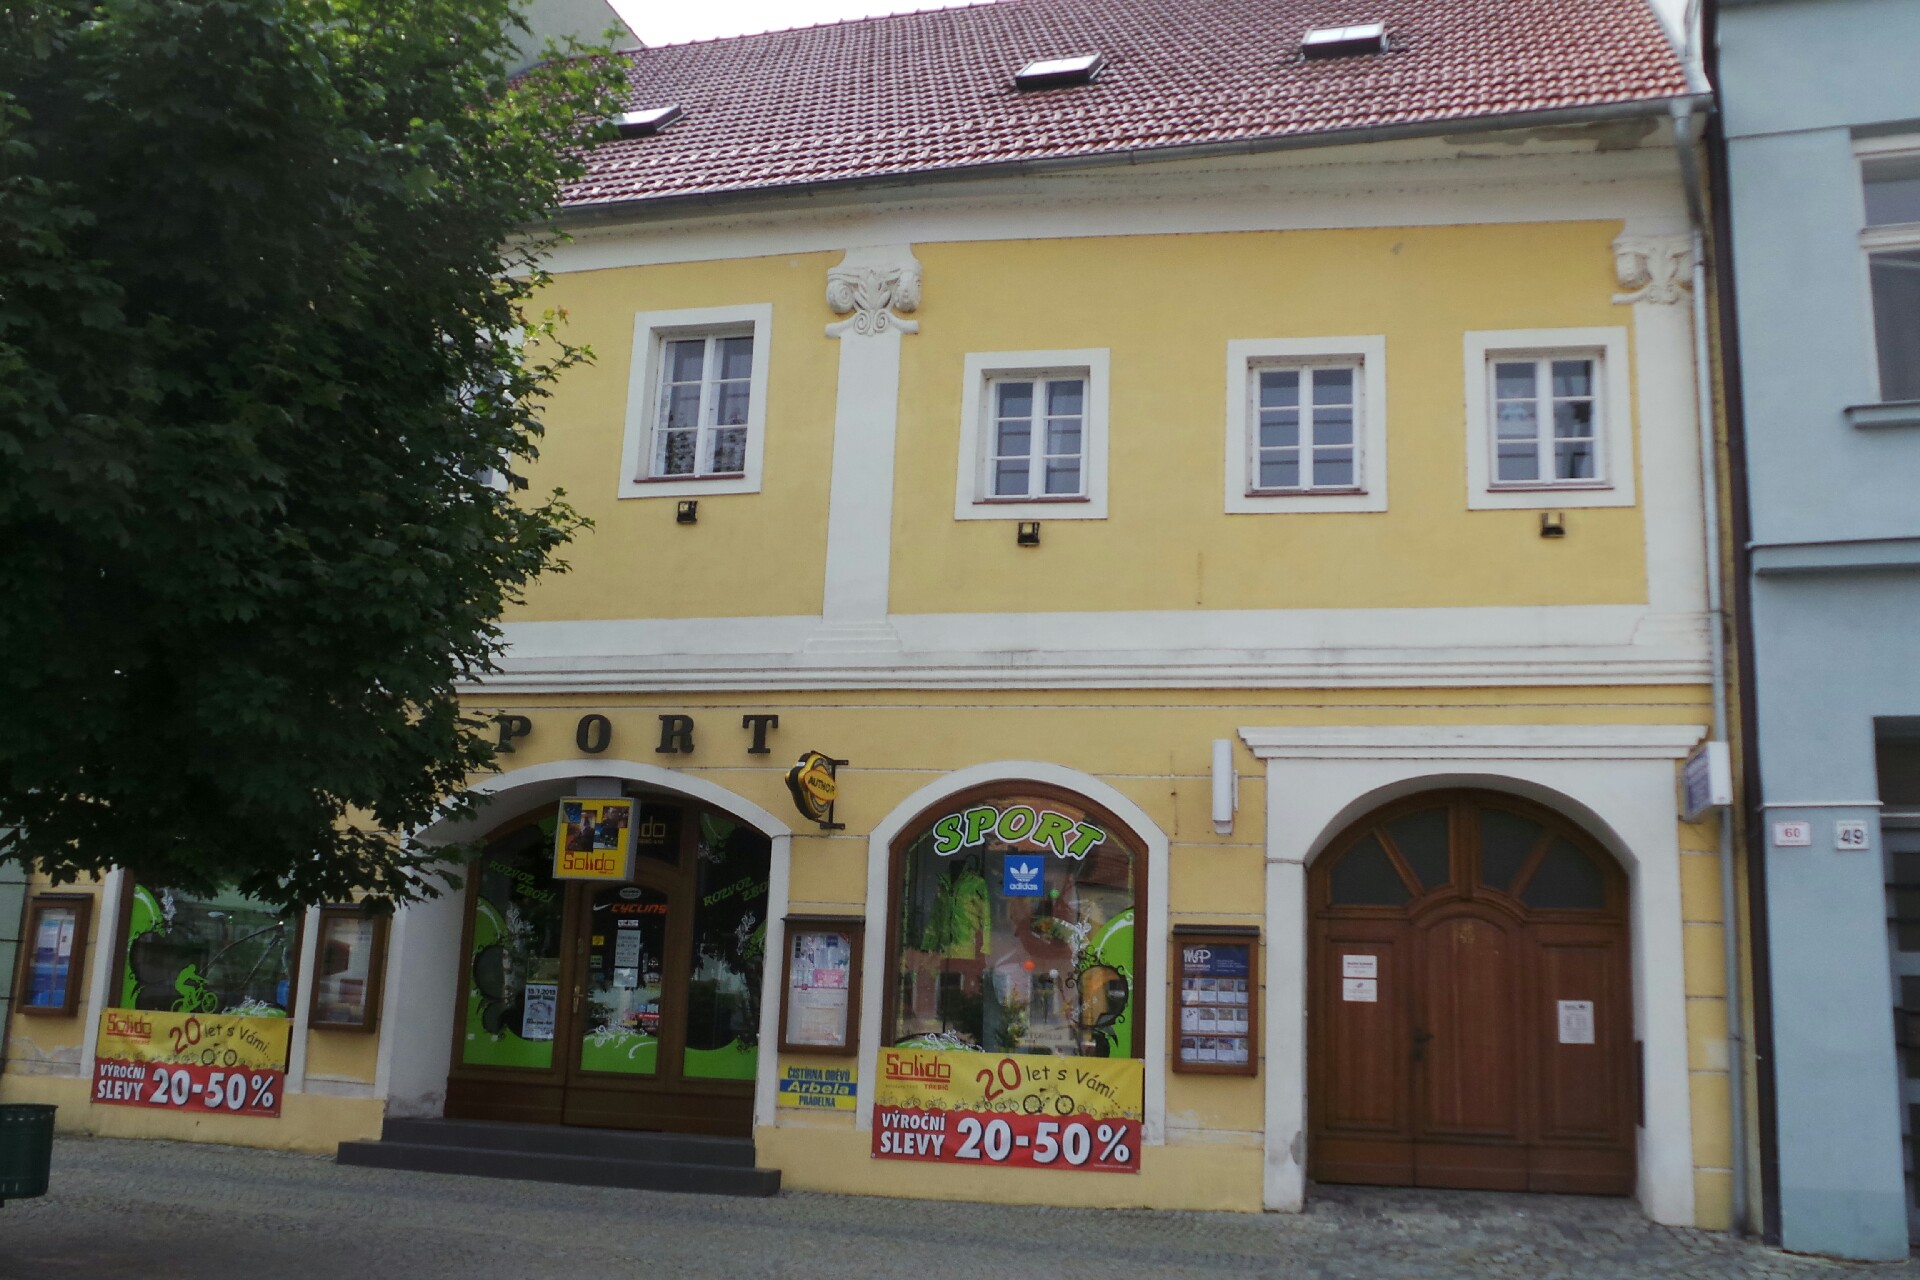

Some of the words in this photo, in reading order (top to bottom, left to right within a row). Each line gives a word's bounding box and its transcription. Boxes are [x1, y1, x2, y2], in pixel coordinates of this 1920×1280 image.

[495, 714, 779, 754] PORT
[808, 776, 835, 794] AUTHOR
[933, 805, 1106, 860] SPORT
[1784, 828, 1801, 837] 60
[1841, 829, 1864, 845] 49
[564, 852, 615, 870] Solido
[703, 876, 754, 907] ROZVOZ
[1009, 882, 1038, 890] adidas
[107, 1013, 152, 1033] Solido
[169, 1017, 201, 1055] 20
[203, 1022, 222, 1038] let
[227, 1027, 234, 1037] s
[100, 1063, 146, 1080] VÝROČNÍ
[886, 1053, 950, 1078] Solido
[788, 1081, 850, 1096] Arbela
[976, 1058, 1022, 1101] 20
[1026, 1065, 1050, 1081] let
[1058, 1069, 1067, 1081] s
[97, 1080, 144, 1101] SLEVY
[881, 1109, 945, 1131] VÝROČNÍ
[880, 1131, 945, 1157] SLEVY
